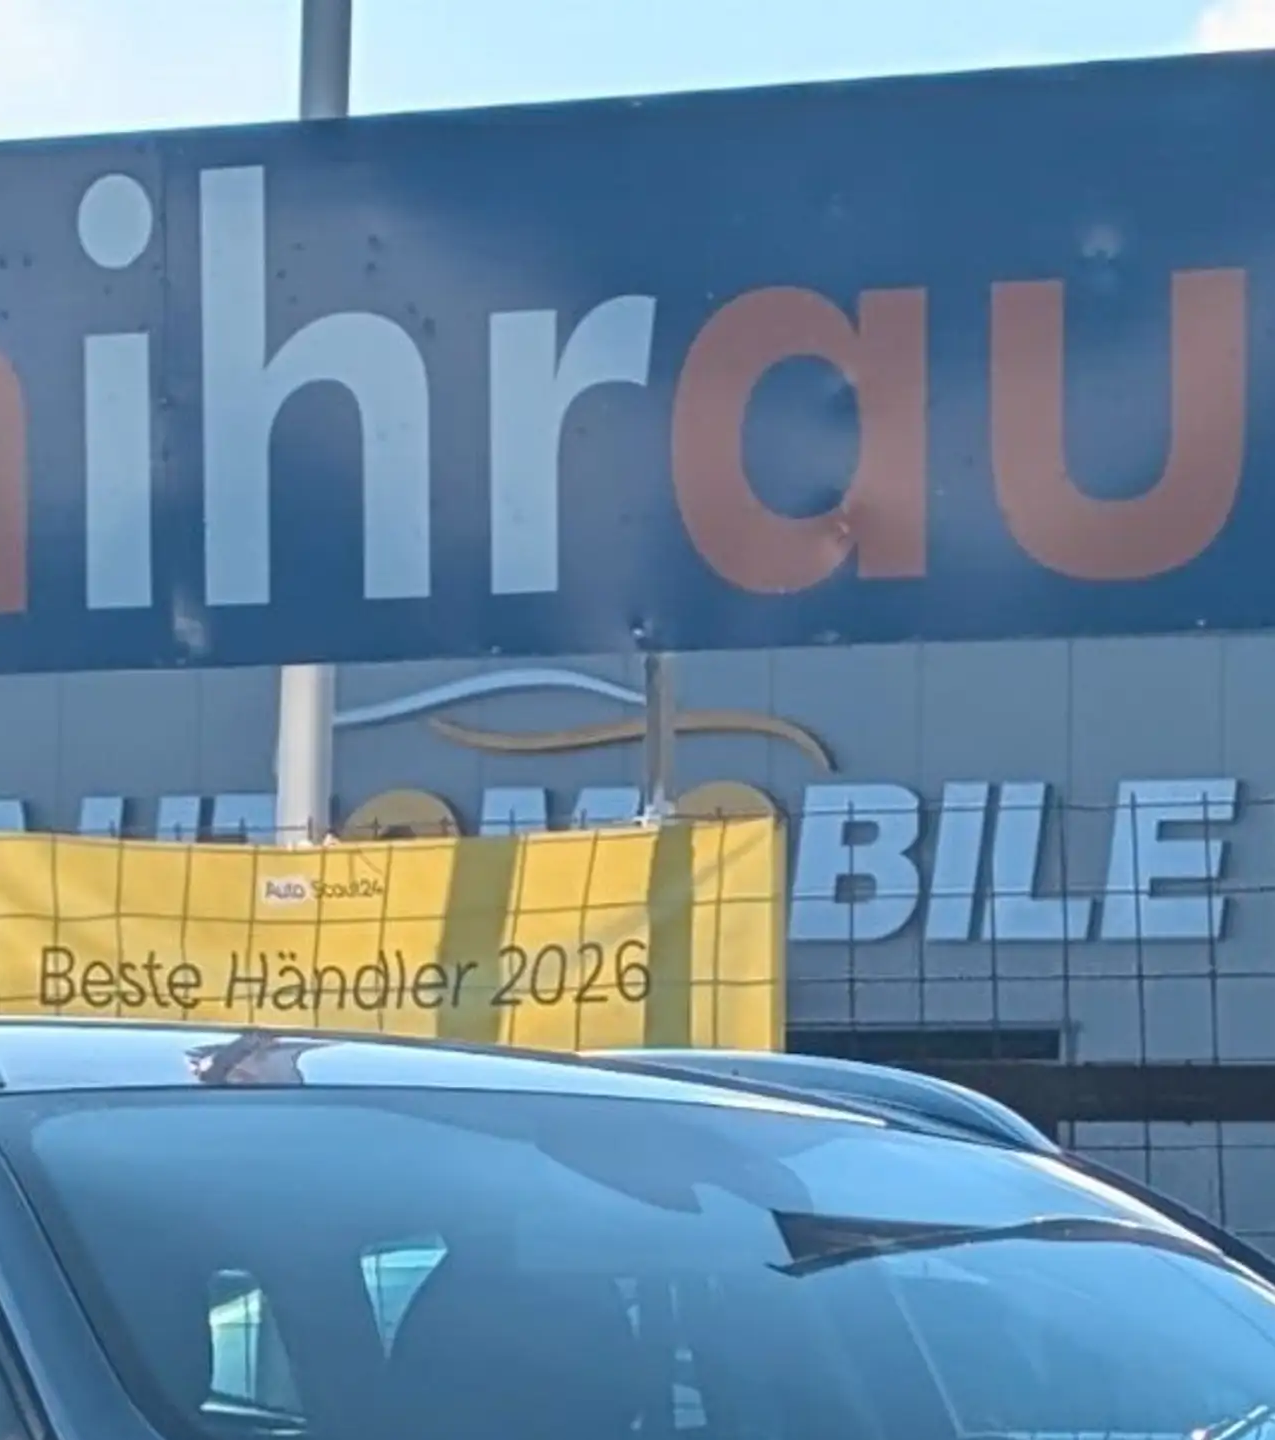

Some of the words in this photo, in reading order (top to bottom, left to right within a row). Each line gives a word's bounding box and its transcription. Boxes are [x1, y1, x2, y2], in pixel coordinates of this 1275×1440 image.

[39, 946, 202, 1008] Beste
[224, 949, 478, 1011] Händler
[490, 939, 652, 1006] 2026
